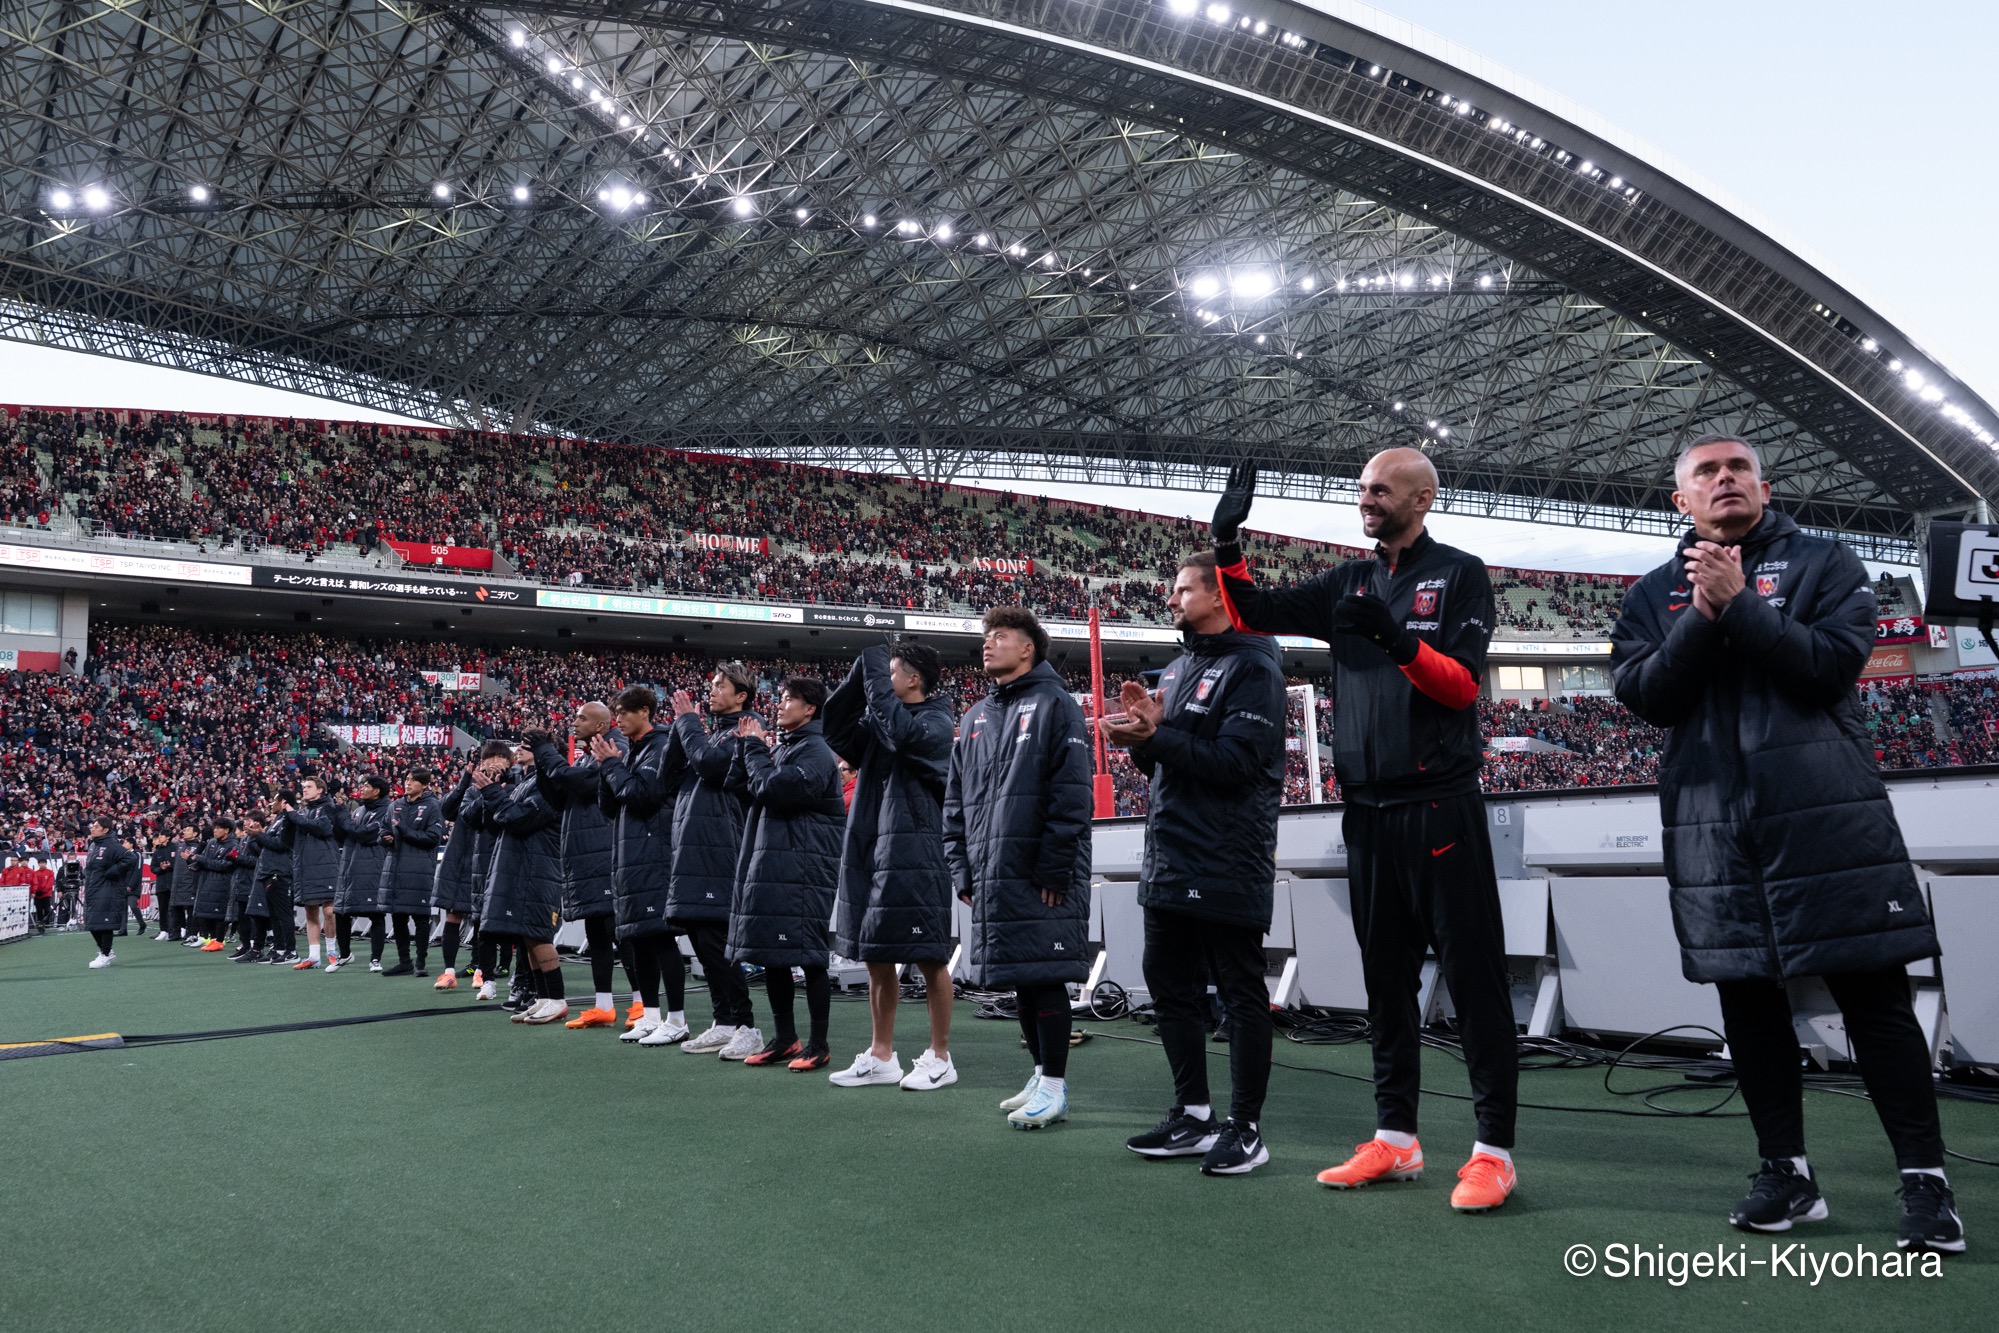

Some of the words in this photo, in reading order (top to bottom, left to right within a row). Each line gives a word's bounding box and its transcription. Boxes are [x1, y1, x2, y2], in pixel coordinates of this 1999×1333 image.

[19, 550, 38, 559] TSP
[431, 546, 448, 555] 505
[94, 558, 112, 566] TSP
[971, 557, 992, 571] AS
[996, 558, 1028, 574] ONE
[550, 594, 591, 607] 明治安田
[613, 598, 651, 611] 明治安田
[728, 606, 765, 619] 明治安田
[1573, 644, 1591, 652] NTN
[0, 651, 14, 660] 08
[440, 673, 457, 681] 309
[380, 726, 398, 736] 214
[1497, 808, 1507, 823] 8
[1188, 889, 1201, 898] XL
[1887, 900, 1903, 913] XL
[1054, 942, 1064, 950] XL
